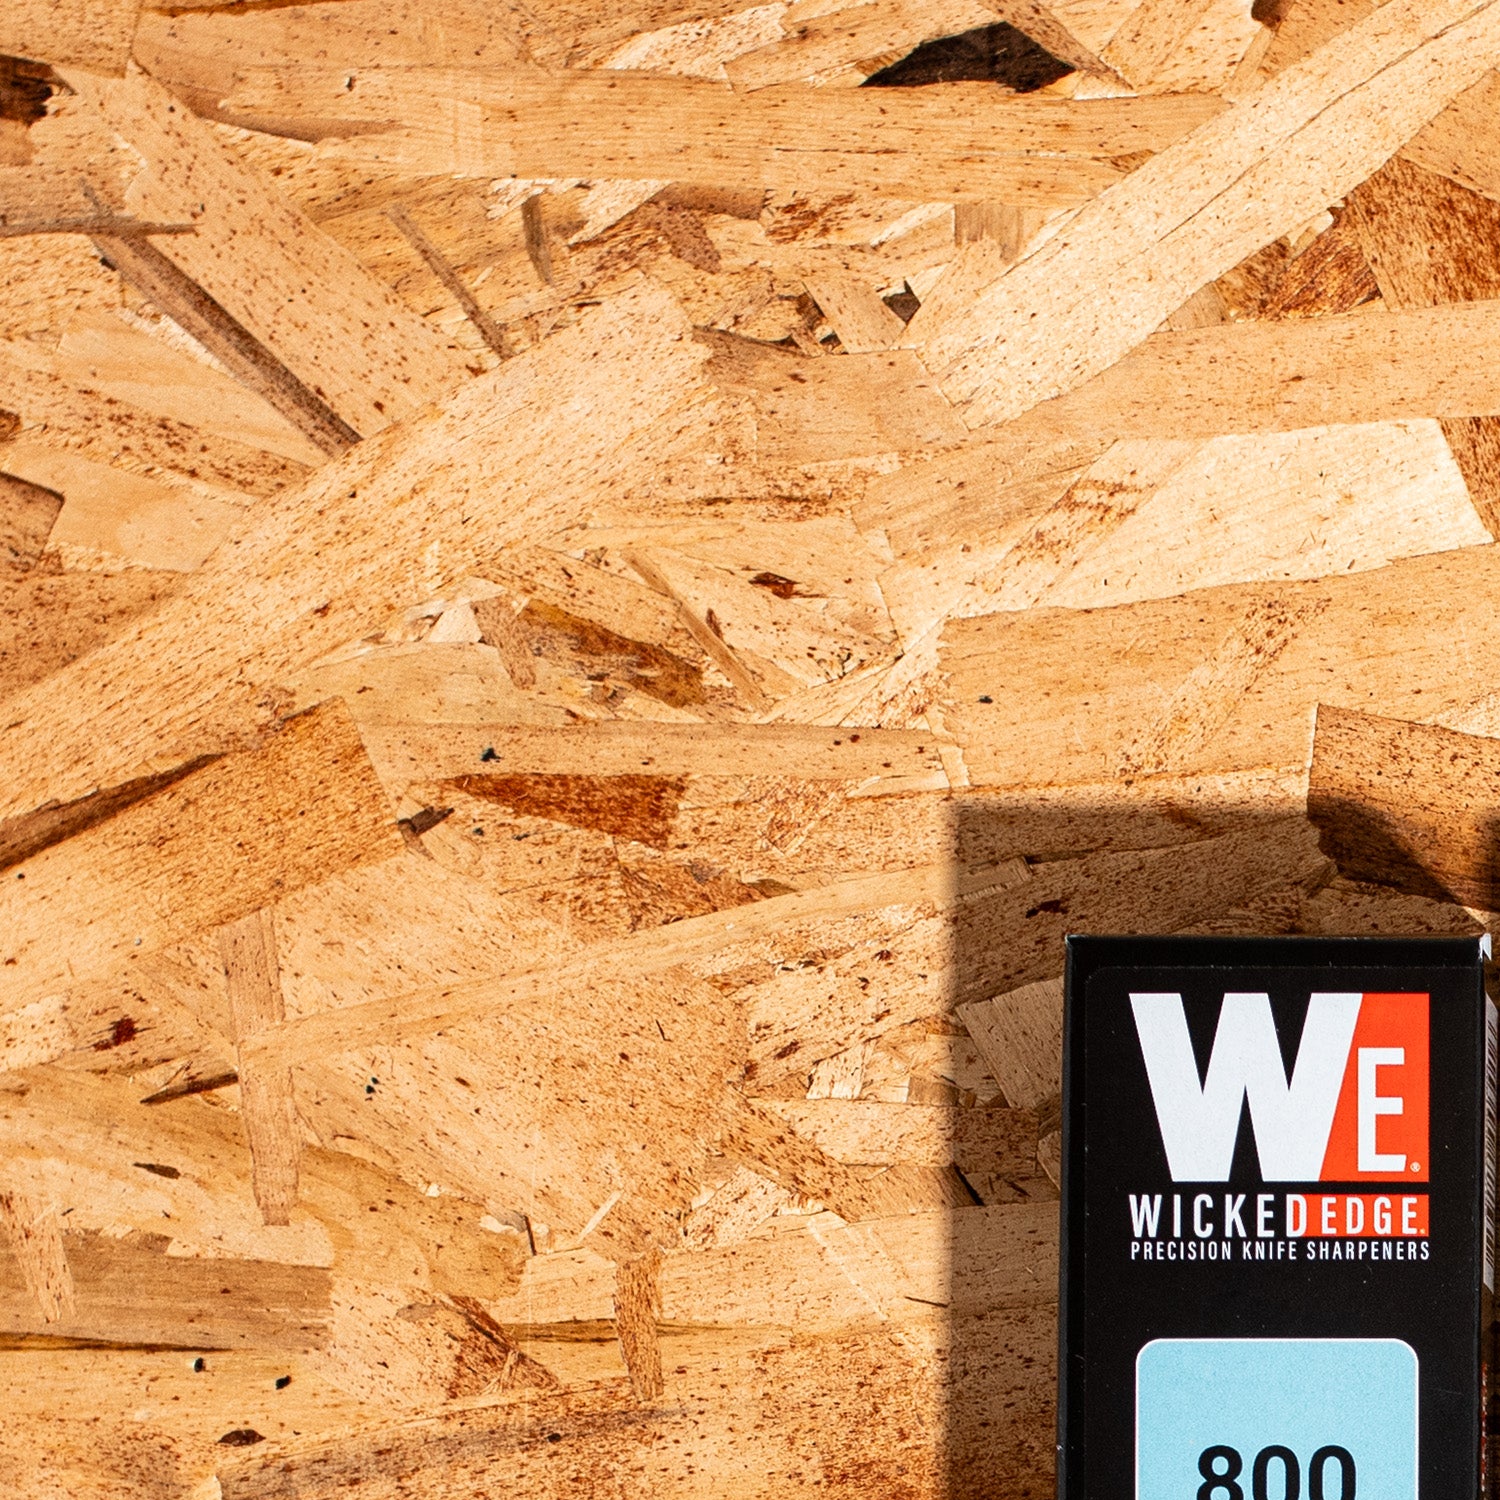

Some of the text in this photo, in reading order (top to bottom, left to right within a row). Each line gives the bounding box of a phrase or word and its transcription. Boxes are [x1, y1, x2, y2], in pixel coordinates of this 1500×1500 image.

[1131, 1240, 1430, 1261] PRECISION KNIFE SHARPENERS
